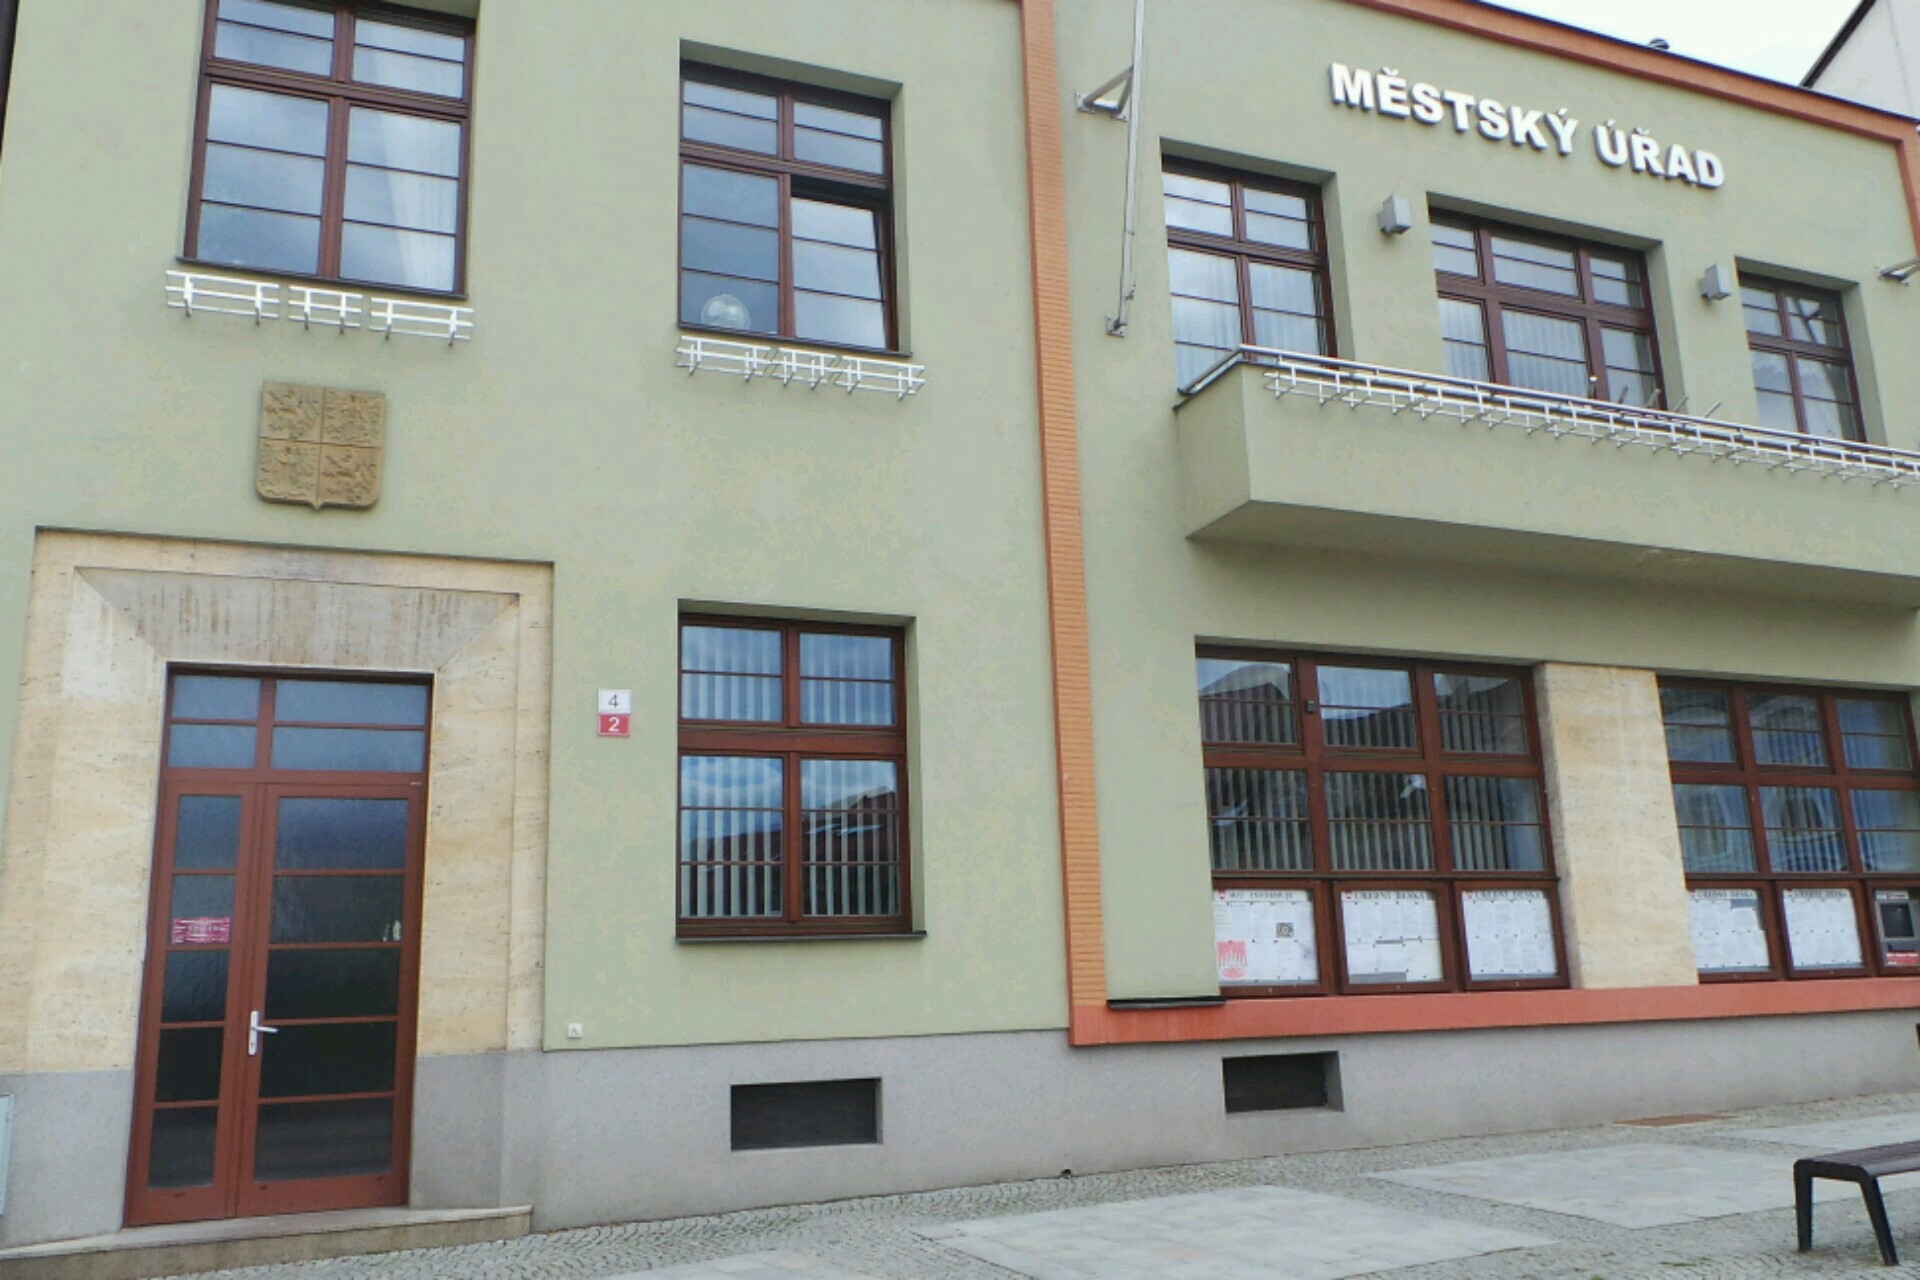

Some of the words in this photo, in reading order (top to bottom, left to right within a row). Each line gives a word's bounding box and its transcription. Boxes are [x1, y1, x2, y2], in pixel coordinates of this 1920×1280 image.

[1330, 62, 1579, 156] MĚSTSKÝ
[1593, 119, 1725, 190] ÚŘAD
[607, 693, 620, 709] 4
[608, 716, 620, 732] 2
